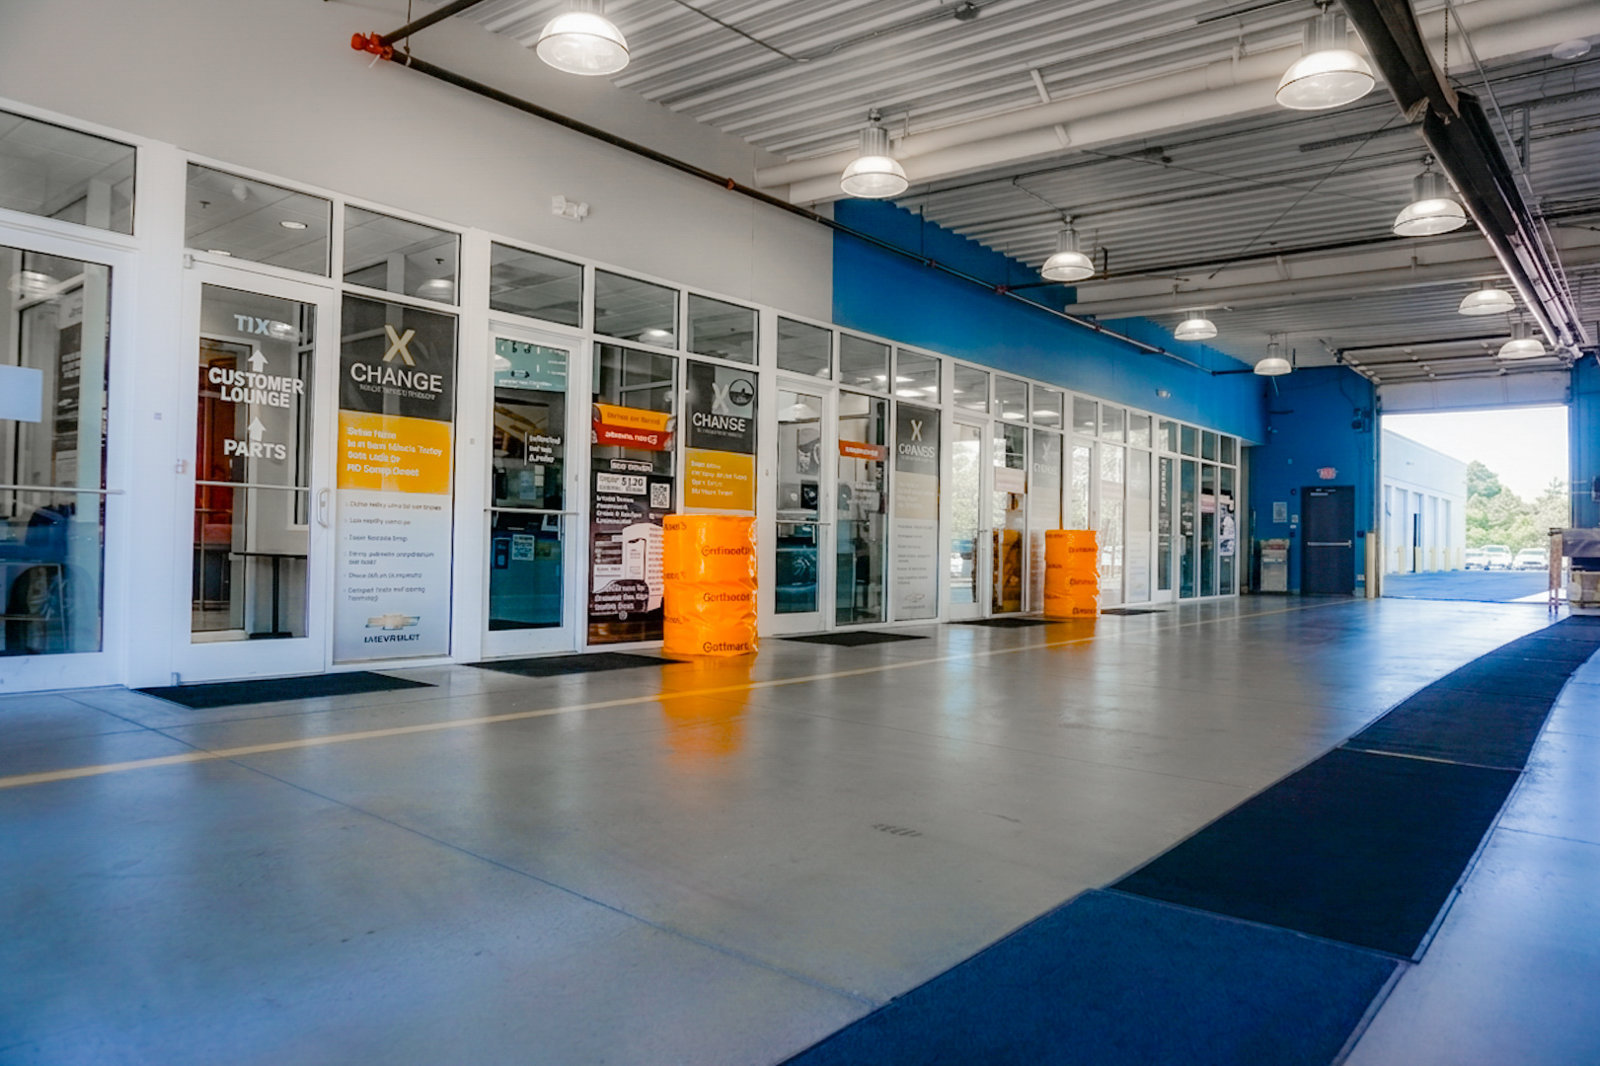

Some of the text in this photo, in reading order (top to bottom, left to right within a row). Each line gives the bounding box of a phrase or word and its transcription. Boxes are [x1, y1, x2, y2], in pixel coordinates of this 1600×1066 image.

[383, 324, 416, 366] X
[208, 367, 304, 395] CUSTOMER
[350, 362, 442, 393] CHANGE
[220, 386, 290, 408] LOUNGE
[224, 439, 287, 460] PARTS
